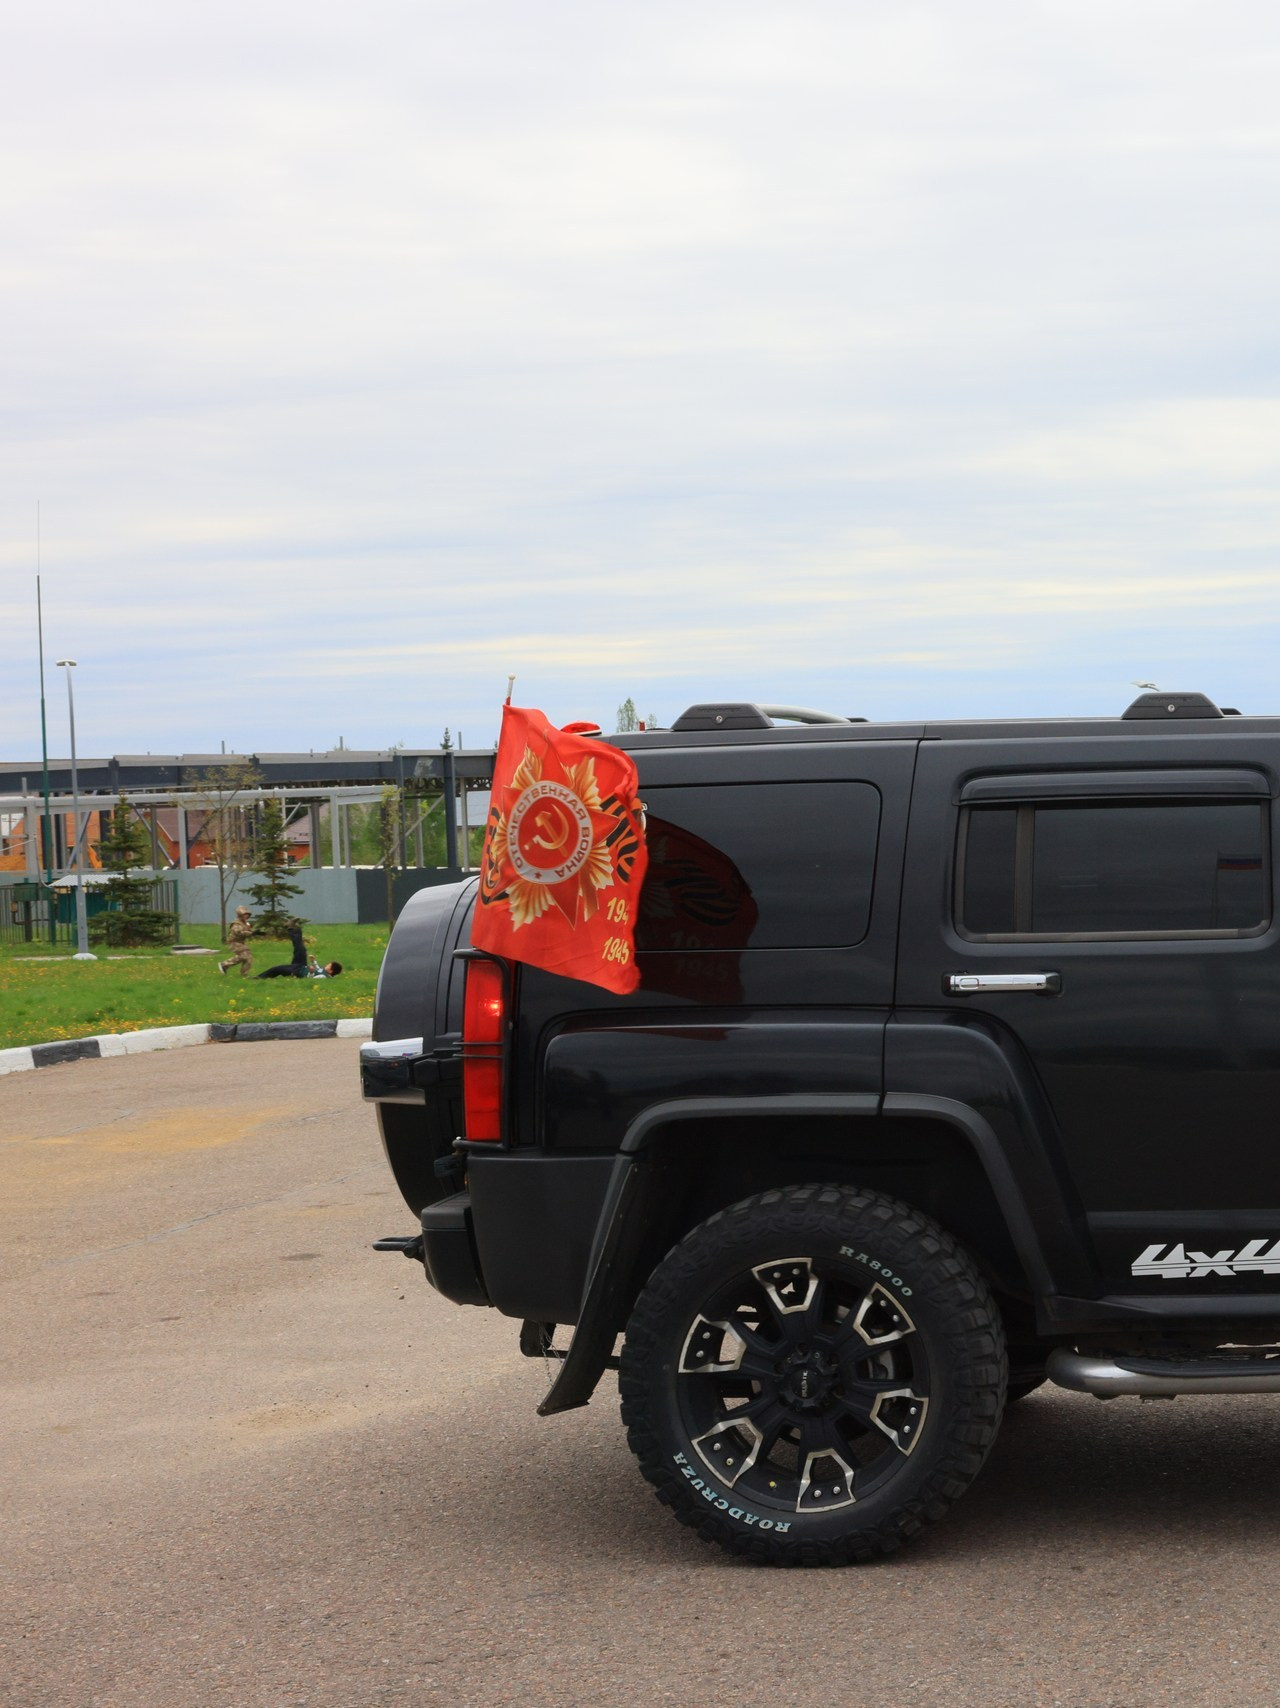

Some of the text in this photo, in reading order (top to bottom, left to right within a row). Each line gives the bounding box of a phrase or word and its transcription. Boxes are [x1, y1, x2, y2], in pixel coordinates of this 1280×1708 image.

[509, 785, 586, 868] ОТЕЧЕСТВЕННАЯ
[602, 936, 629, 965] 1945
[840, 1245, 912, 1297] RA8000
[673, 1451, 791, 1533] ROADCRUZA
